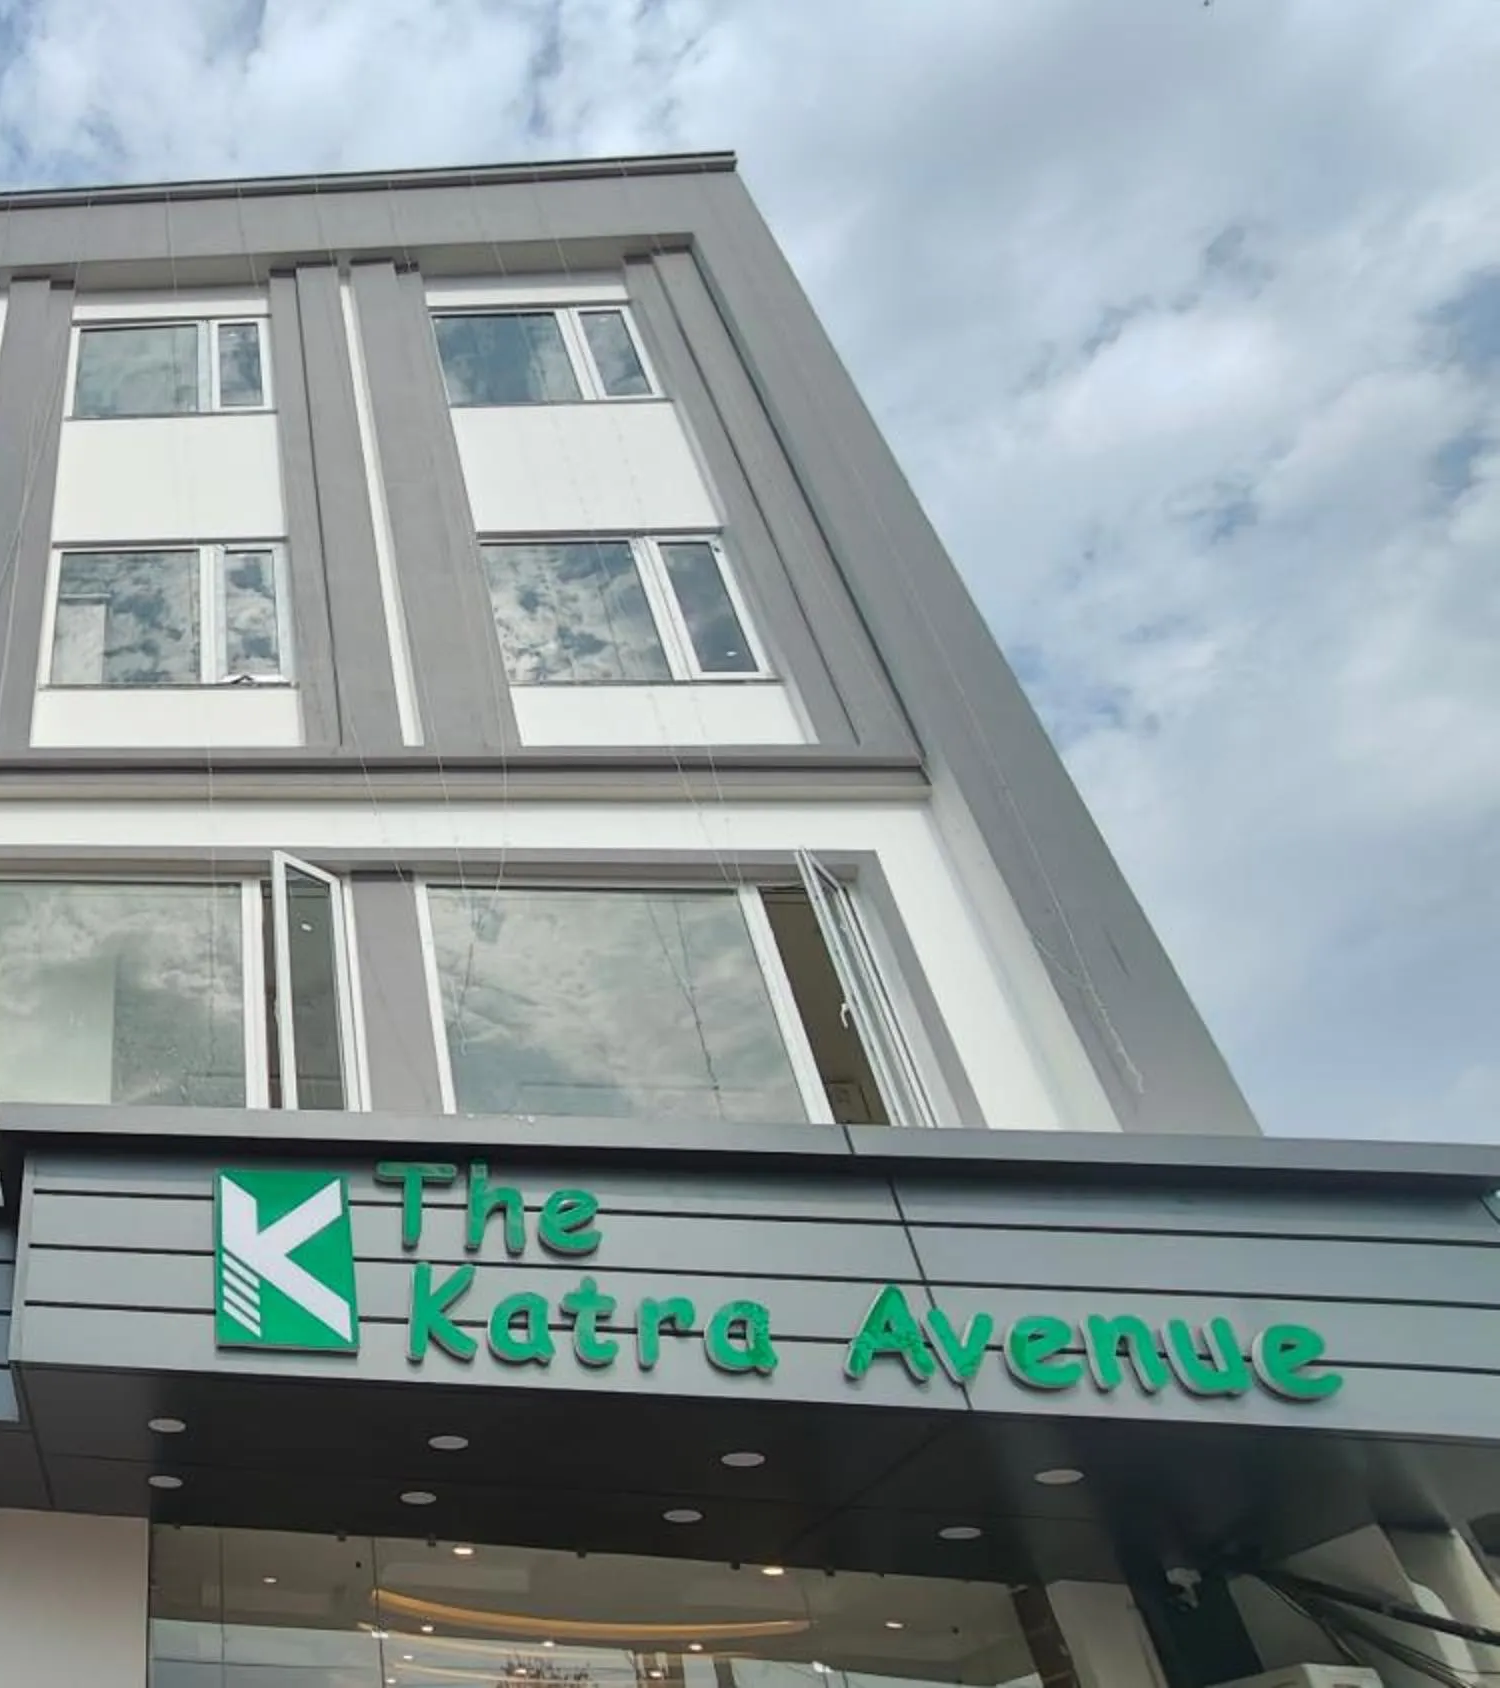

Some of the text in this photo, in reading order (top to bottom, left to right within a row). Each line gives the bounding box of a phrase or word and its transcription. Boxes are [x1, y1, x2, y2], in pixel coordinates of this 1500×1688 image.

[220, 1173, 354, 1344] K
[374, 1154, 603, 1254] The
[407, 1260, 1345, 1400] Katra Avenue
